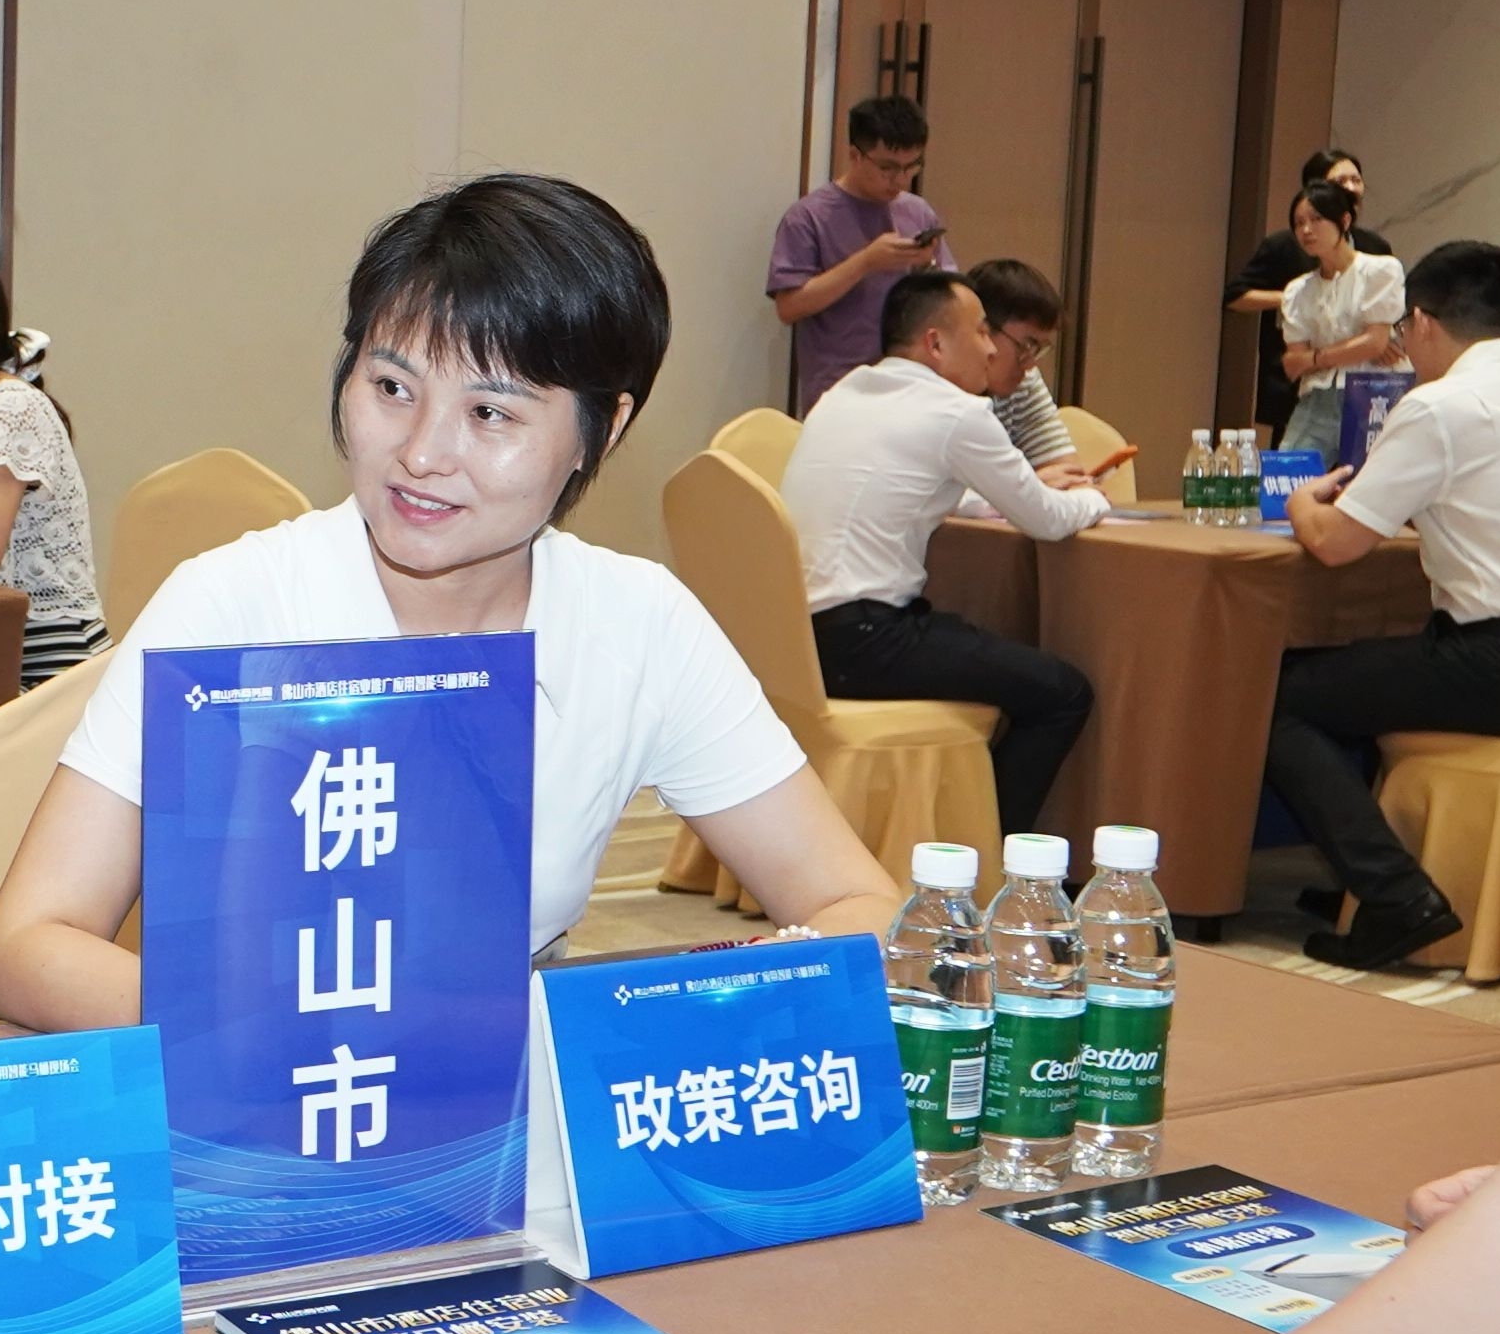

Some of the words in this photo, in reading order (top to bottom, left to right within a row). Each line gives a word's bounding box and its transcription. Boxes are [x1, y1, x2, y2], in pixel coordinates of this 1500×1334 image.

[290, 747, 398, 1163] 佛山市
[1020, 1087, 1046, 1098] Purified
[1081, 1072, 1109, 1086] Drinking
[1111, 1075, 1131, 1086] Water
[1084, 1087, 1111, 1100] Limited
[1113, 1089, 1138, 1101] Edition
[610, 1049, 861, 1151] 政策咨询
[1048, 1184, 1272, 1236] 佛山市酒店住宿业
[1105, 1201, 1283, 1244] 智能马桶安装
[1186, 1224, 1298, 1256] 补贴申领
